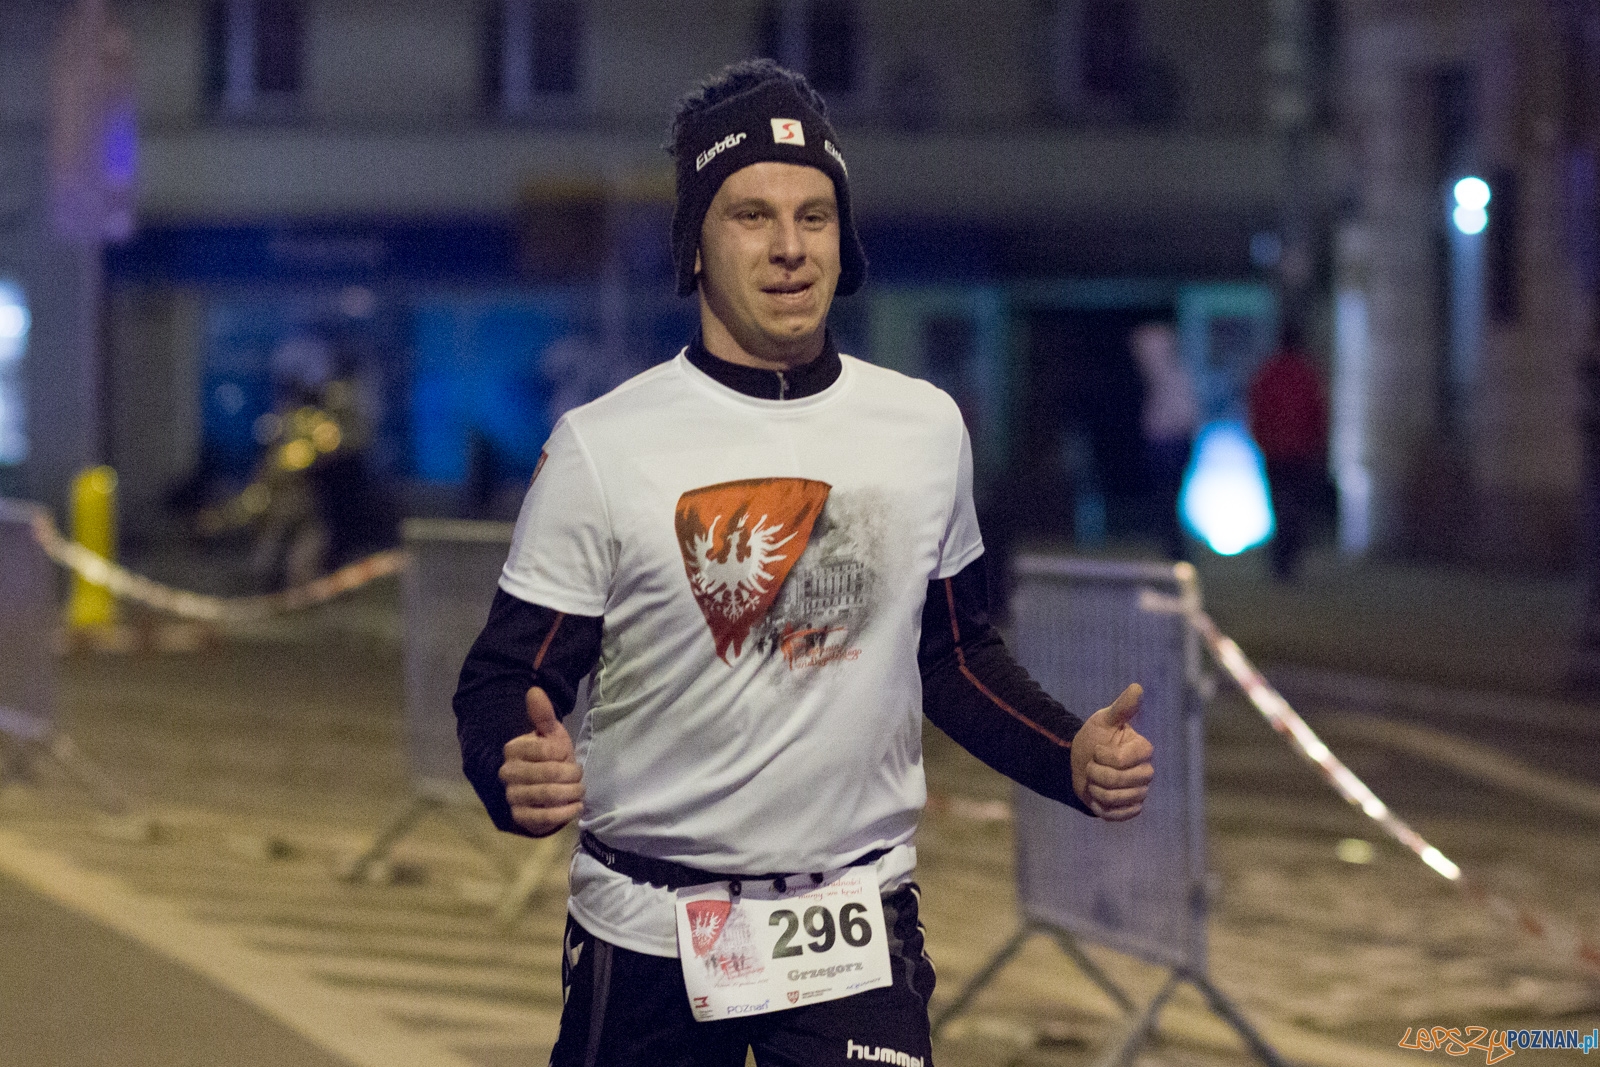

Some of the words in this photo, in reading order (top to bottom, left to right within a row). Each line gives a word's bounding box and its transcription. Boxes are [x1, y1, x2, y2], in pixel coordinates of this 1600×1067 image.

[696, 132, 747, 172] Eisbär
[768, 902, 872, 960] 296
[787, 960, 864, 982] Grzegorz
